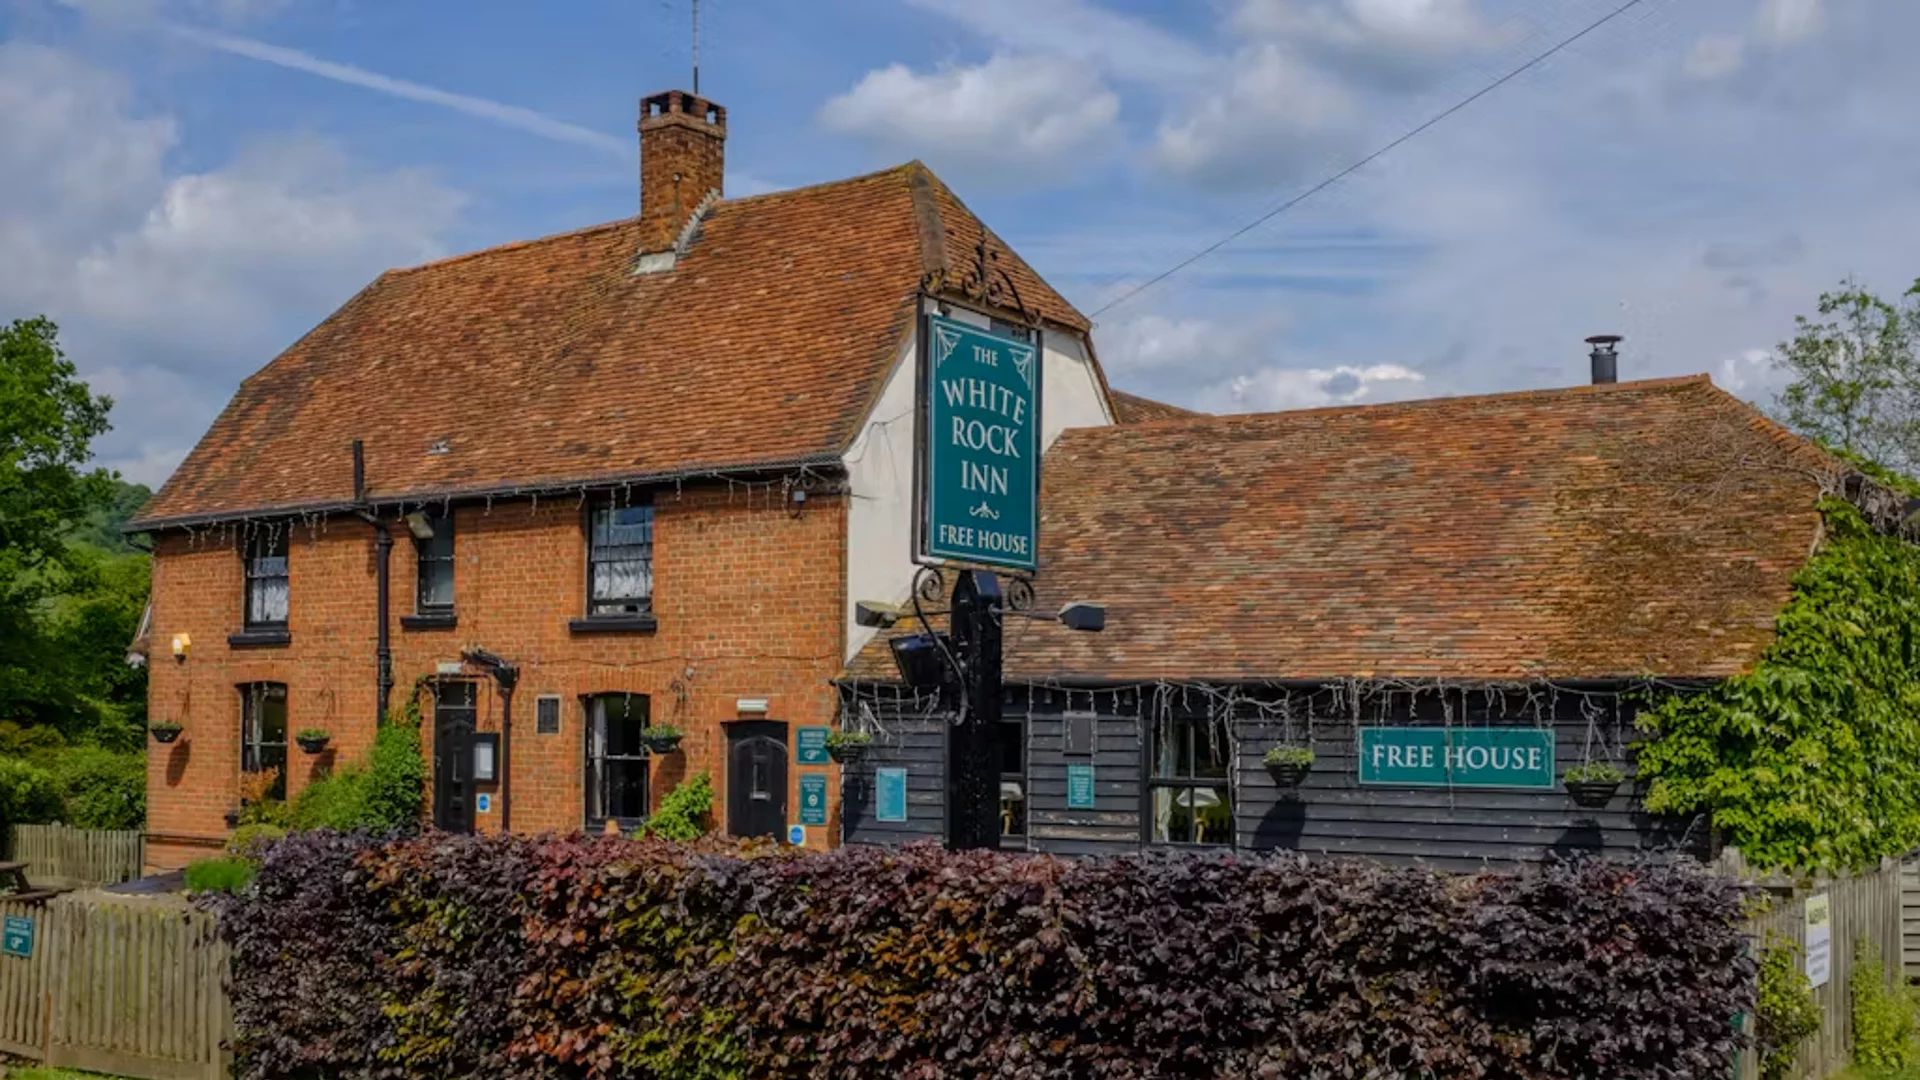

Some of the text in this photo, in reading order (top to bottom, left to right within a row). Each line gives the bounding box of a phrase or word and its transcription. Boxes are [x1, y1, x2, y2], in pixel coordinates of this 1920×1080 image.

[973, 346, 998, 366] THE
[942, 378, 1026, 424] WHITE
[952, 416, 1020, 458] ROCK
[961, 460, 1008, 496] INN
[939, 524, 1028, 554] FREE HOUSE
[1373, 745, 1541, 769] FREE HOUSE
